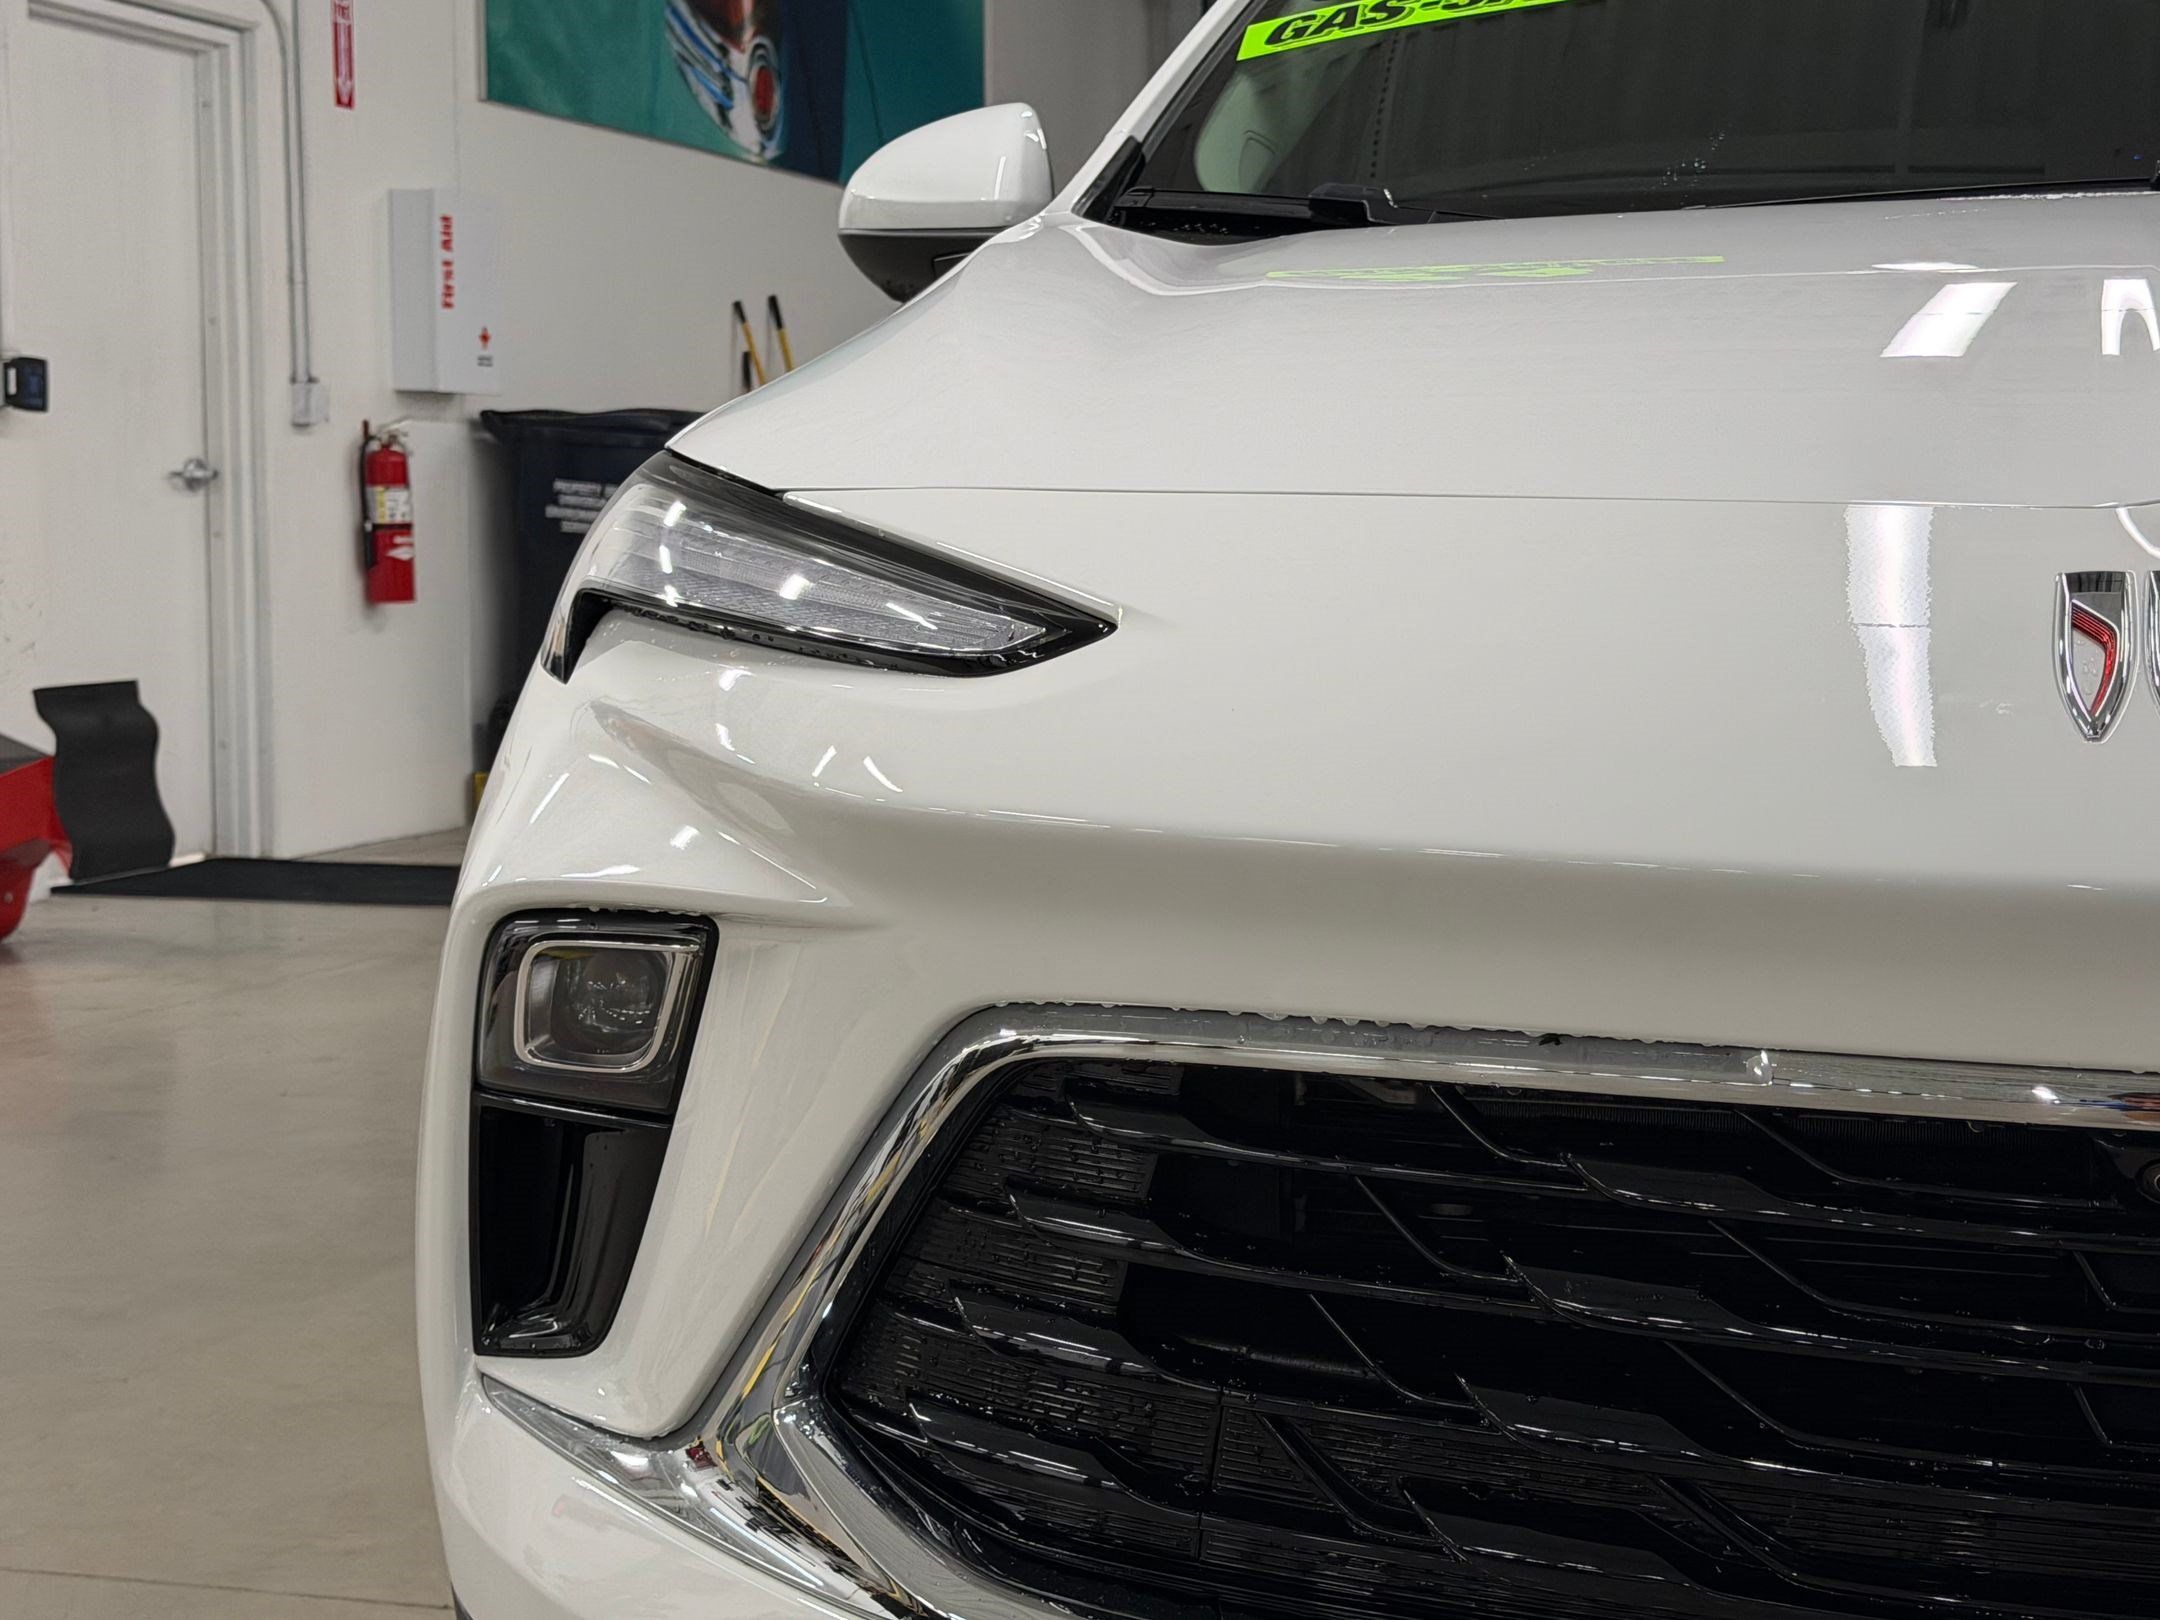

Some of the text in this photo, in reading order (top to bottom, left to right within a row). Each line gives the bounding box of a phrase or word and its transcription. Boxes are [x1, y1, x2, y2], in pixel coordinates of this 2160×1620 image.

[1264, 0, 1502, 45] GAS-
[440, 215, 454, 309] First Aid
